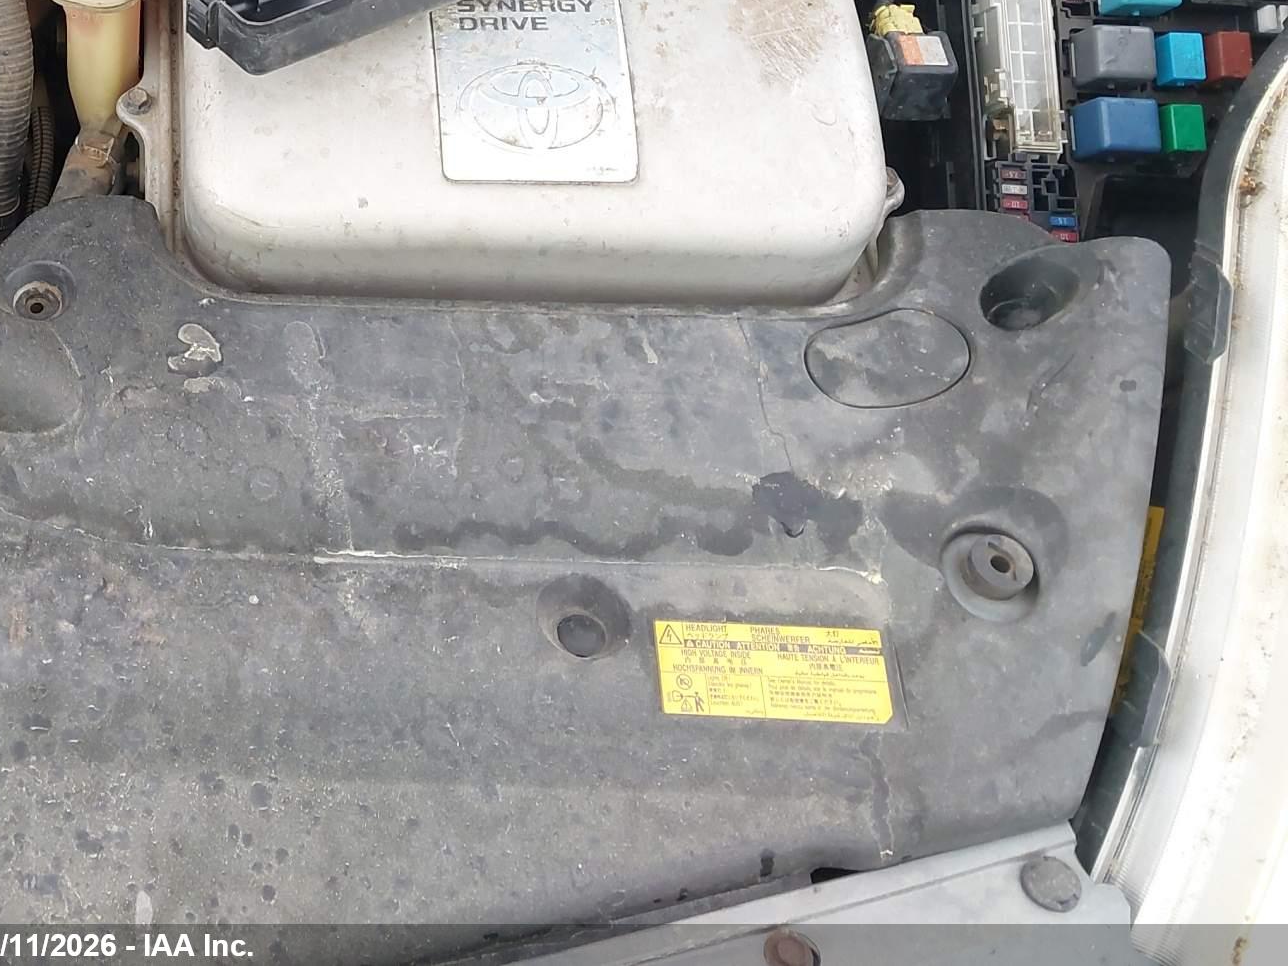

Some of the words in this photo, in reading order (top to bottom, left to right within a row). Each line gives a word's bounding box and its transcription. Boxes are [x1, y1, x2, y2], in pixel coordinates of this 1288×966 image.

[459, 17, 549, 31] DRIVE
[686, 624, 727, 633] HEADLIGHT
[750, 626, 780, 634] PHARES
[751, 634, 811, 643] SCHEINWERFER
[695, 640, 730, 649] CAUTION
[737, 642, 780, 651] ATTENTION
[808, 646, 846, 655] ACHTUNG
[681, 649, 698, 657] HIGH
[700, 650, 729, 658] VOLTAGE
[777, 653, 799, 661] HAUTE
[801, 654, 830, 663] TENSION
